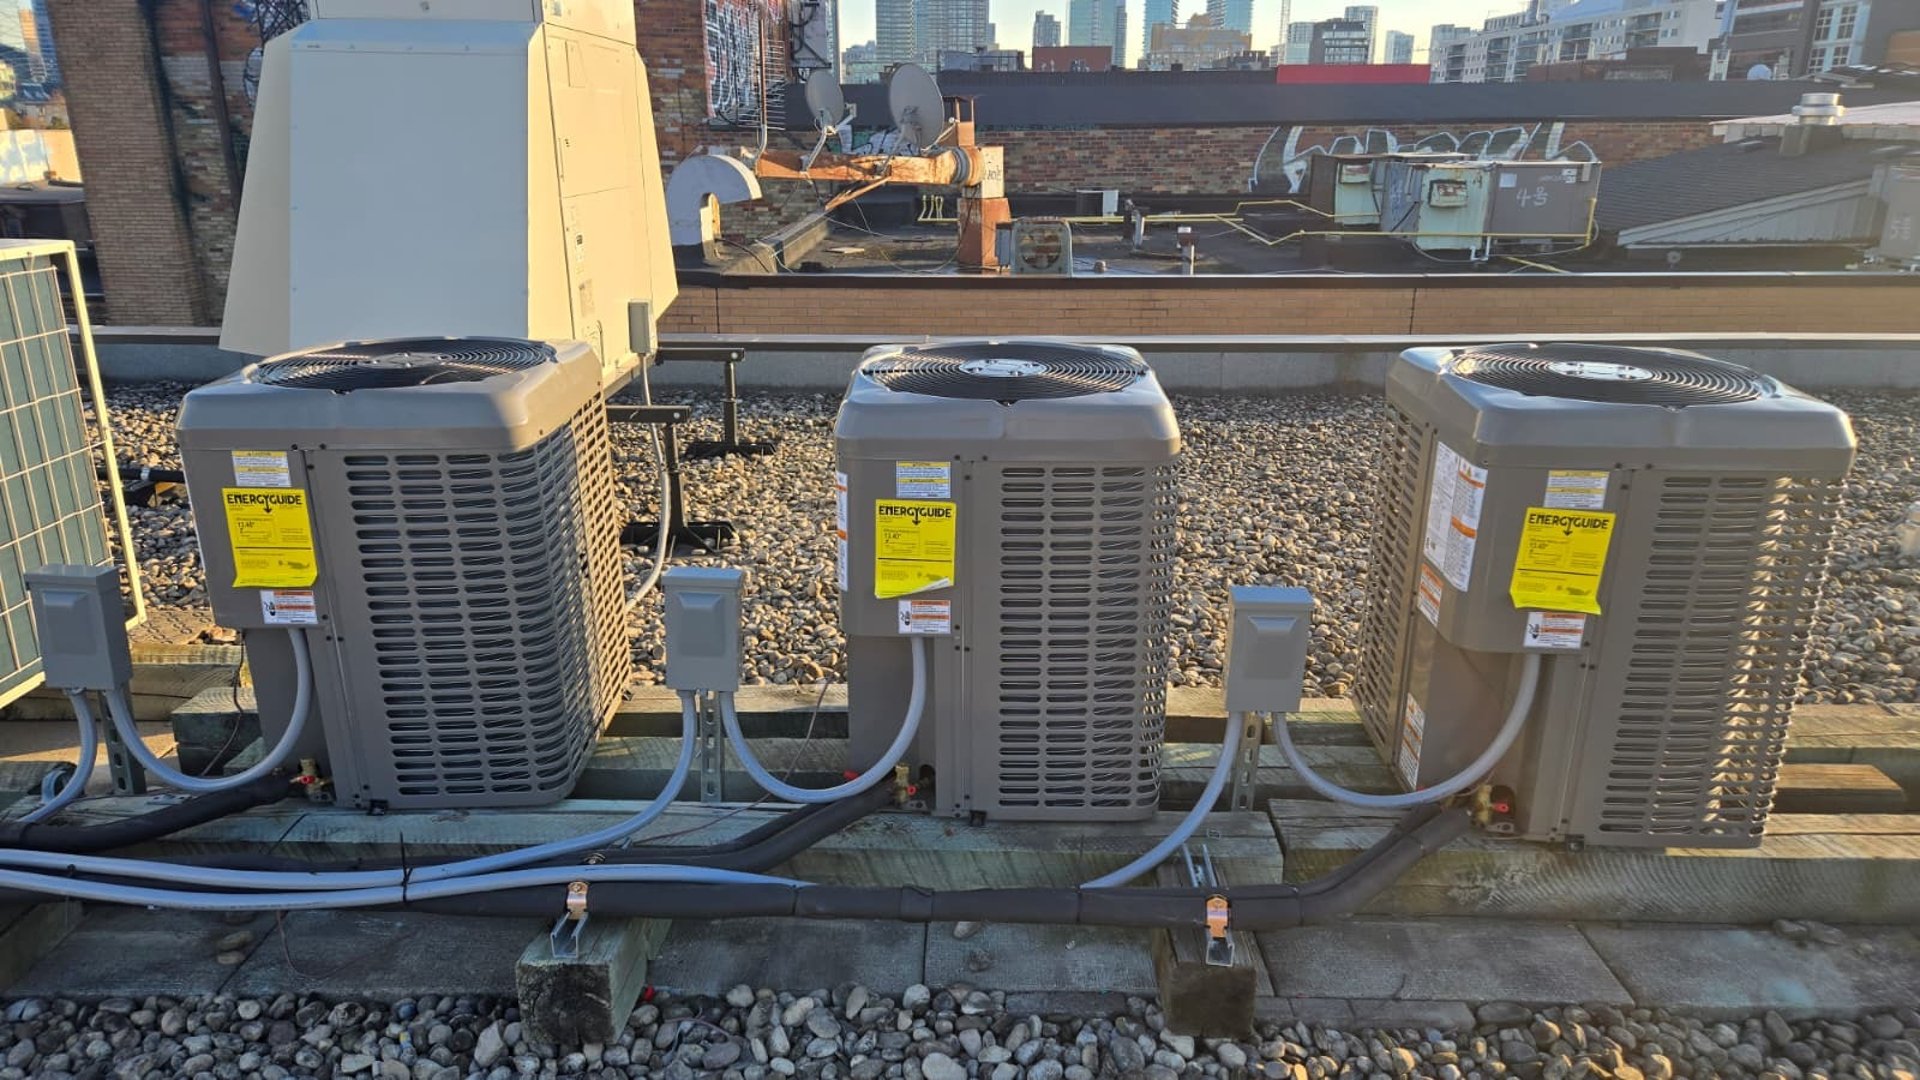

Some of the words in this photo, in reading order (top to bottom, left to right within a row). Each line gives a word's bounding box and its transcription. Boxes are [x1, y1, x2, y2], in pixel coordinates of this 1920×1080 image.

[227, 494, 303, 505] ENERGYGUIDE
[879, 505, 952, 519] ENERGYGUIDE
[1528, 514, 1610, 529] ENERGYGUIDE
